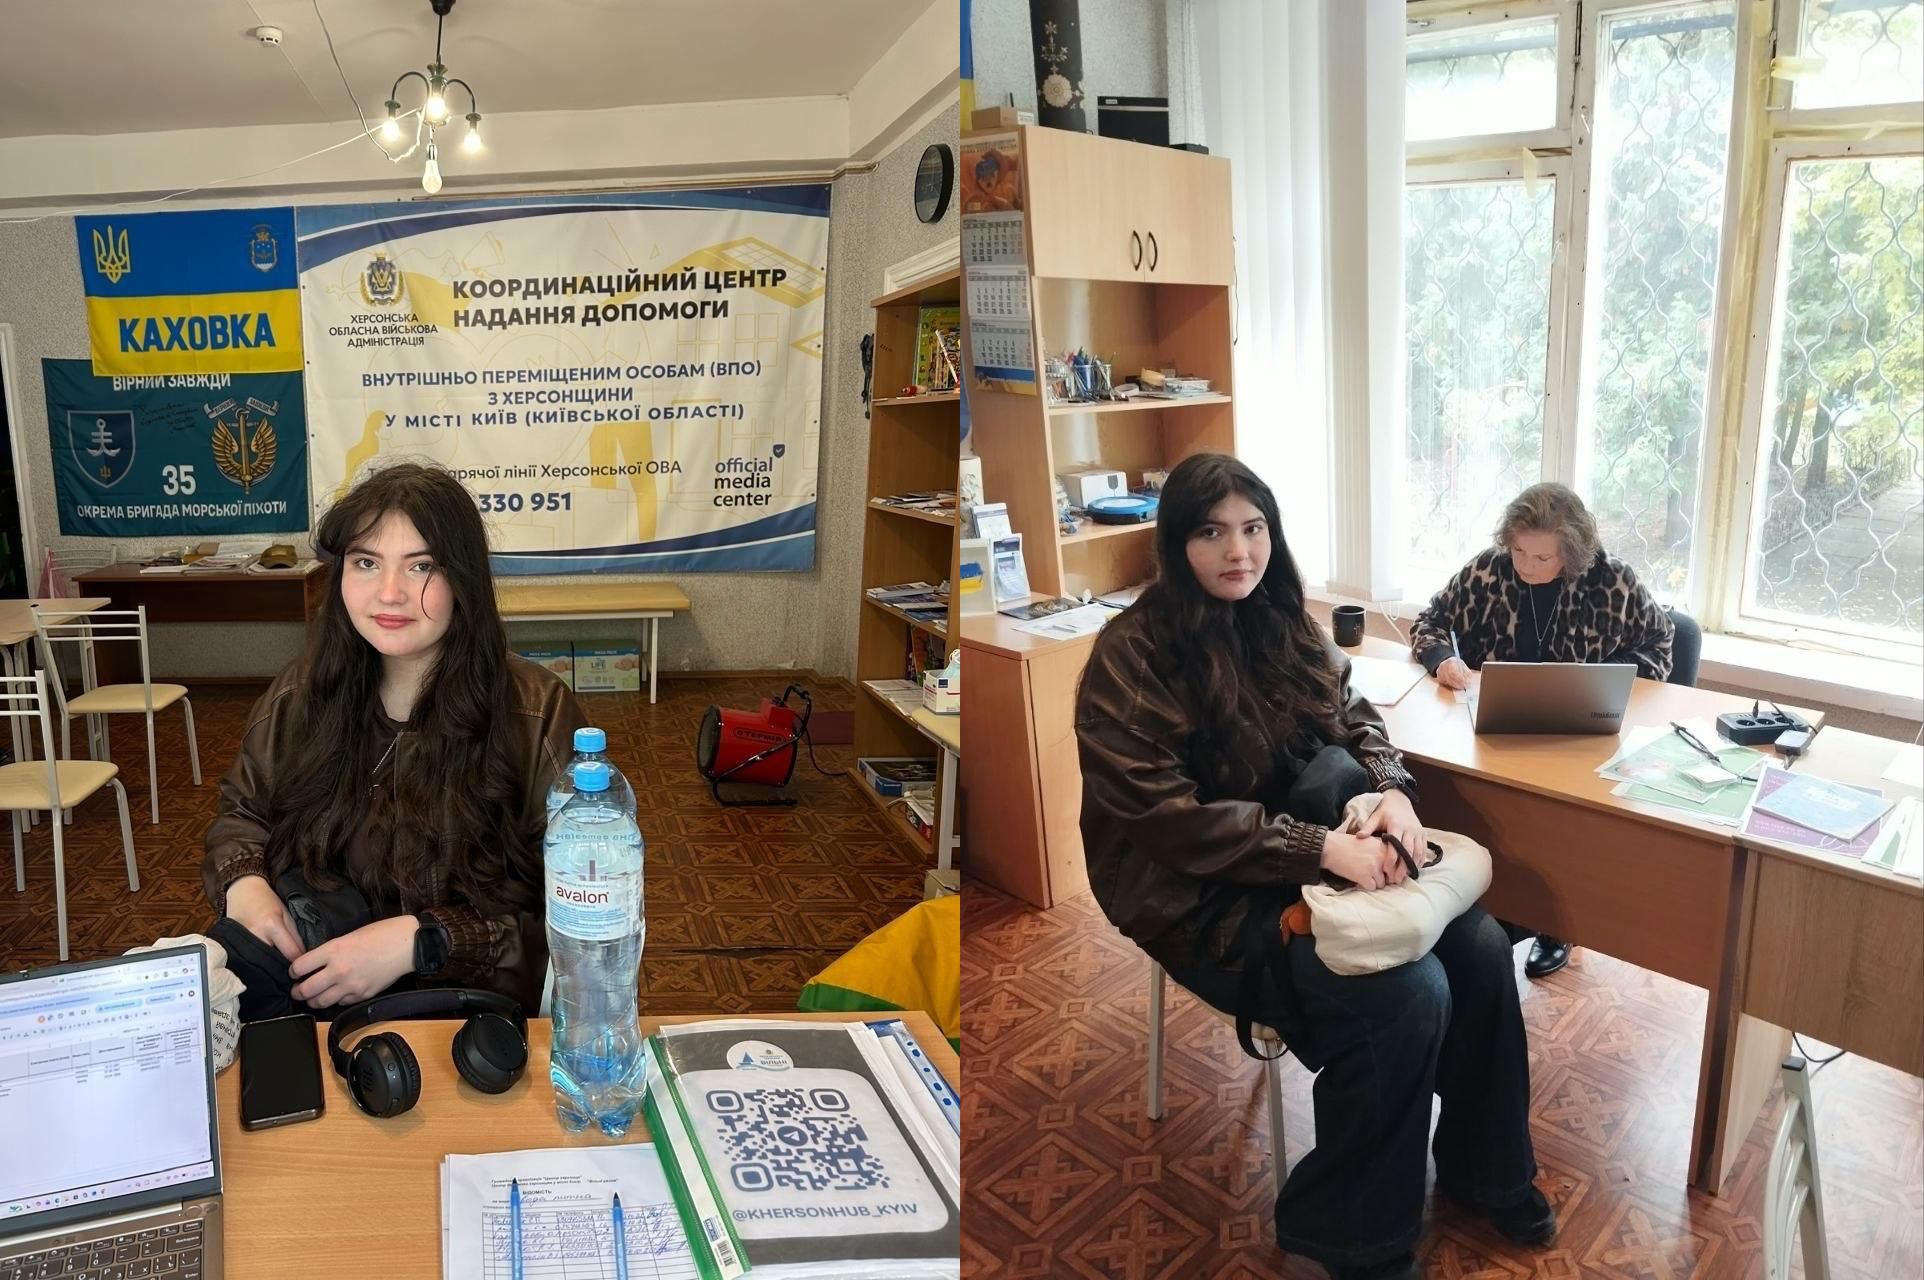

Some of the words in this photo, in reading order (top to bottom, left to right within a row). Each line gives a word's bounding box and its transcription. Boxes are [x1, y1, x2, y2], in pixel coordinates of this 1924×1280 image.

[453, 269, 698, 301] КООРДИНАЦІЙНИЙ
[703, 267, 787, 292] ЦЕНТР
[350, 312, 419, 325] ХЕРСОНСЬКА
[453, 306, 575, 330] НАДАННЯ
[581, 300, 730, 327] ДОПОМОГИ
[119, 312, 276, 353] КАХОВКА
[329, 325, 380, 337] ОБЛАСНА
[381, 322, 438, 335] ВІЙСЬКОВА
[347, 334, 425, 349] АДМІНІСТРАЦІЯ
[168, 375, 231, 390] ЗАВЖДИ
[362, 370, 478, 388] ВНУТРІШНЬО
[482, 366, 622, 386] ПЕРЕМІЩЕНИМ
[625, 363, 705, 381] ОСОБАМ
[709, 358, 762, 378] (ВПО)
[488, 392, 498, 406] З
[501, 386, 633, 406] ХЕРСОНЩИНИ
[385, 414, 397, 428] У
[404, 413, 461, 427] МІСТІ
[471, 410, 518, 426] КИЇВ
[525, 406, 642, 426] (КИЇВСЬКОЇ
[648, 402, 745, 421] ОБЛАСТІ)
[450, 464, 500, 483] арячої
[503, 465, 537, 478] лінії
[540, 461, 642, 479] Херсонської
[646, 461, 682, 475] ОВА
[714, 457, 773, 474] official
[162, 464, 197, 496] 35
[713, 473, 771, 491] media
[479, 493, 524, 513] 330
[530, 492, 573, 512] 951
[713, 490, 772, 507] center
[77, 504, 125, 519] ОКРЕМА
[126, 503, 180, 520] БРИГАДА
[181, 499, 242, 518] МОРСЬКОЇ
[244, 500, 288, 515] ПІХОТИ
[556, 886, 608, 904] avalon
[732, 1202, 918, 1224] @KHERSONHUB_KYIV
